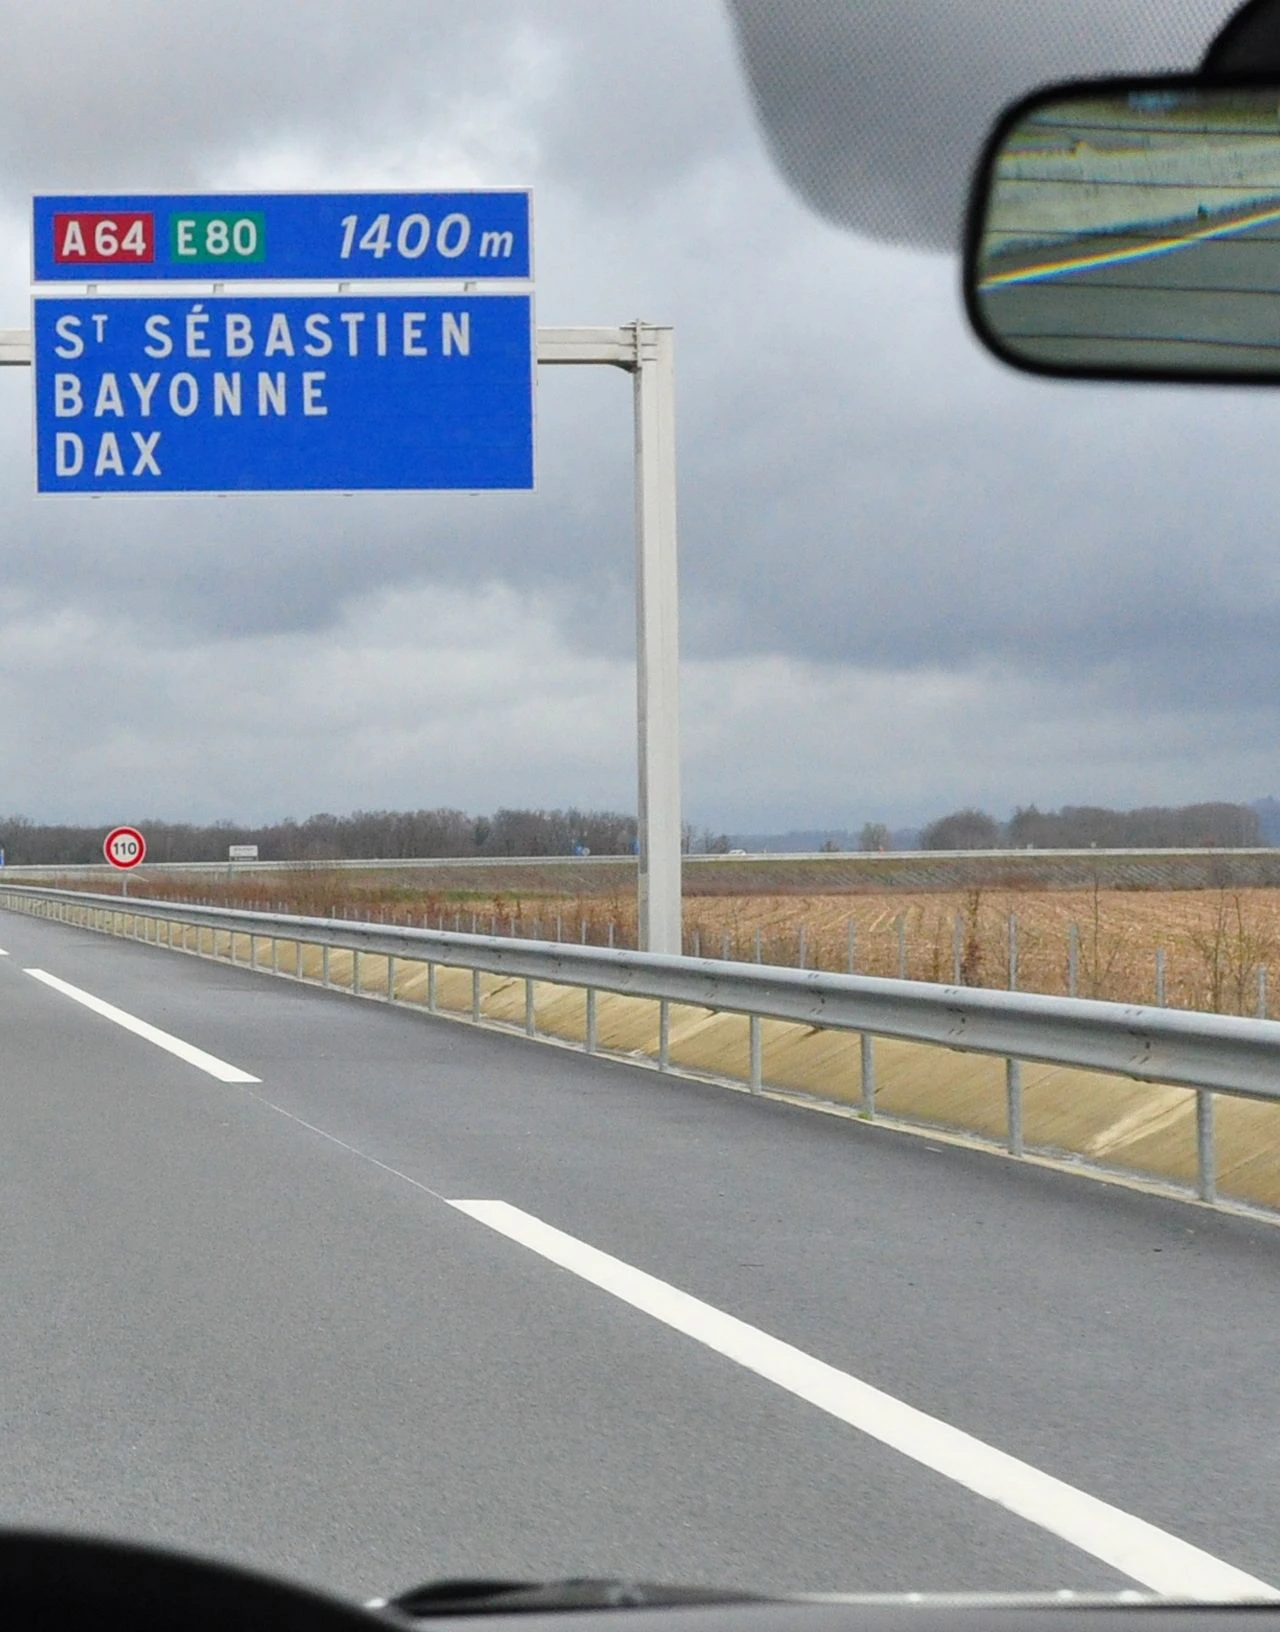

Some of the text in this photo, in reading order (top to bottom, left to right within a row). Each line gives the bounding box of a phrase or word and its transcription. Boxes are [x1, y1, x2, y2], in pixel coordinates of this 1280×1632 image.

[340, 213, 513, 259] 1400 m
[144, 304, 470, 358] SÉBASTIEN
[55, 371, 328, 417] BAYONNE
[56, 431, 161, 477] DAX
[113, 842, 137, 855] 110
